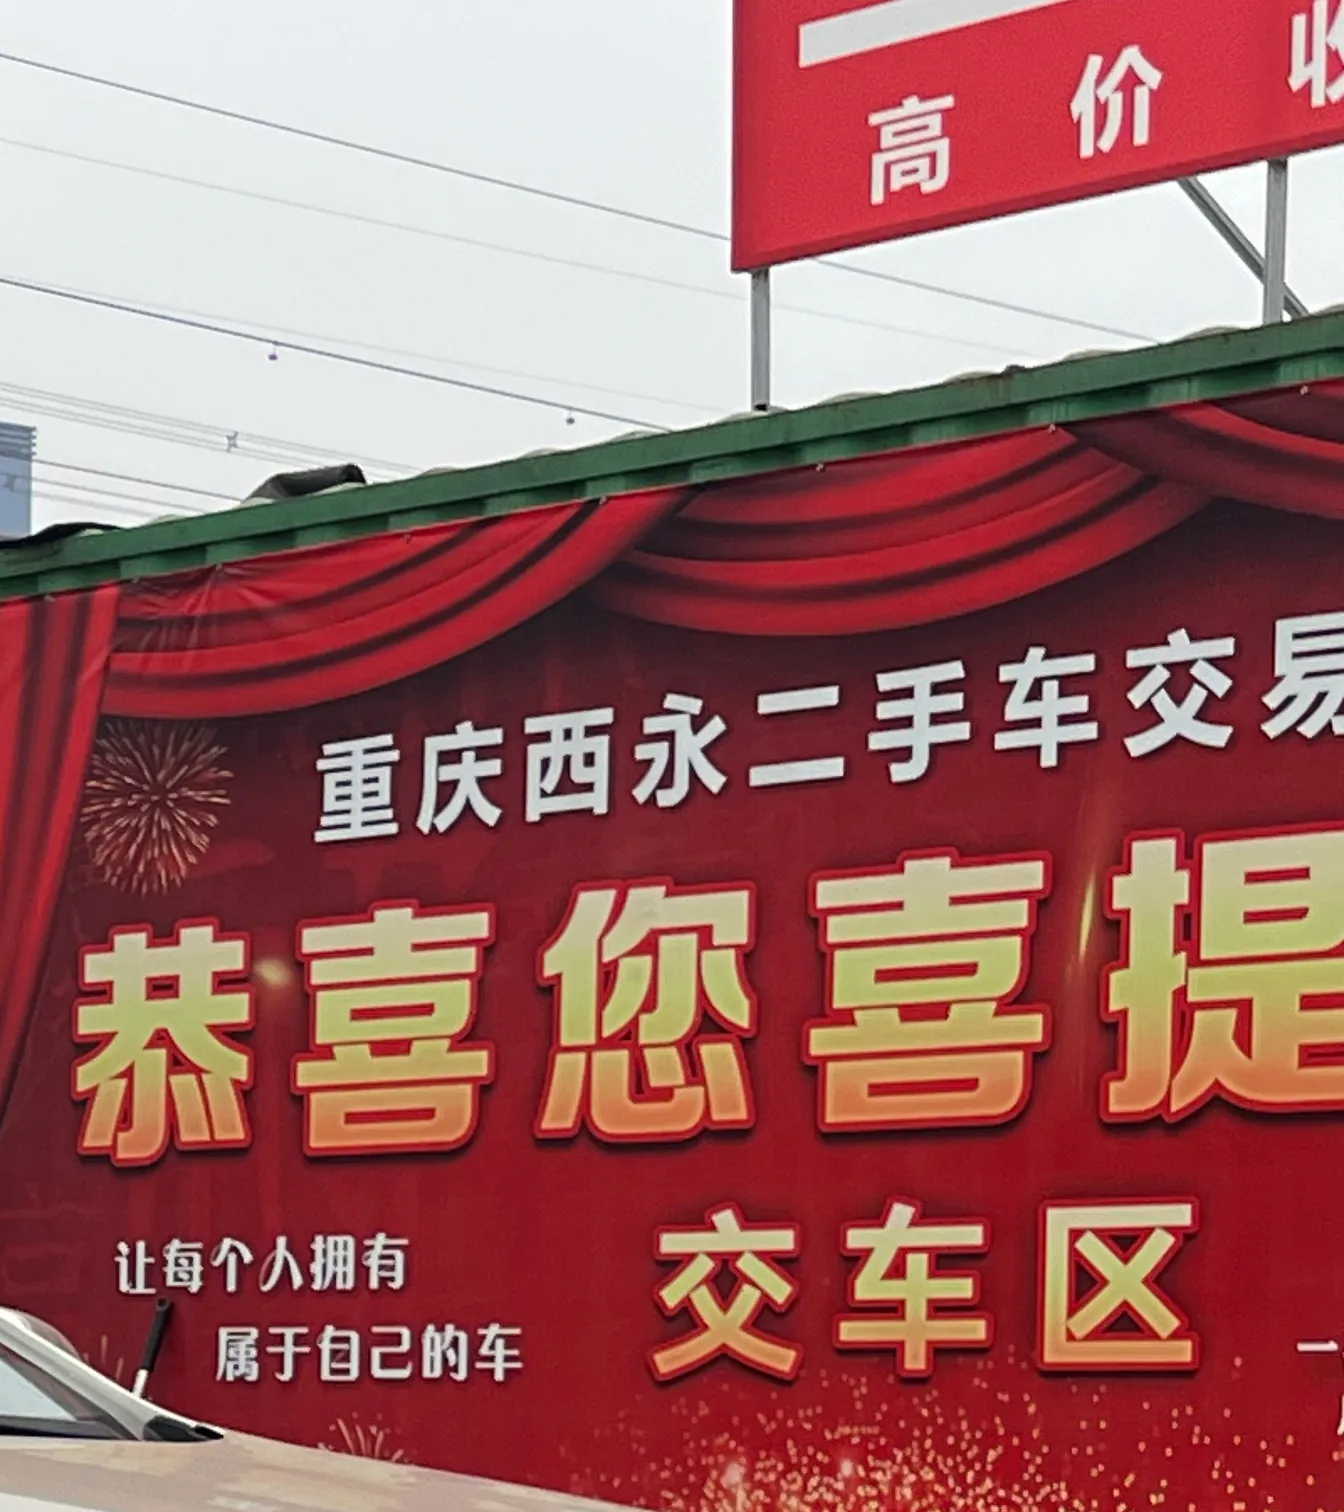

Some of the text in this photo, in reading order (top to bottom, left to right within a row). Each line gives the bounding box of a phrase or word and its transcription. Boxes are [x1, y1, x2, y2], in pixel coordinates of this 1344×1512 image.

[315, 612, 1344, 842] 重庆西永二手车交易
[75, 830, 1344, 1159] 恭喜您喜提
[115, 1233, 408, 1293] 让每个人拥有
[655, 1203, 1191, 1372] 交车区
[216, 1324, 523, 1381] 属于自己的车
